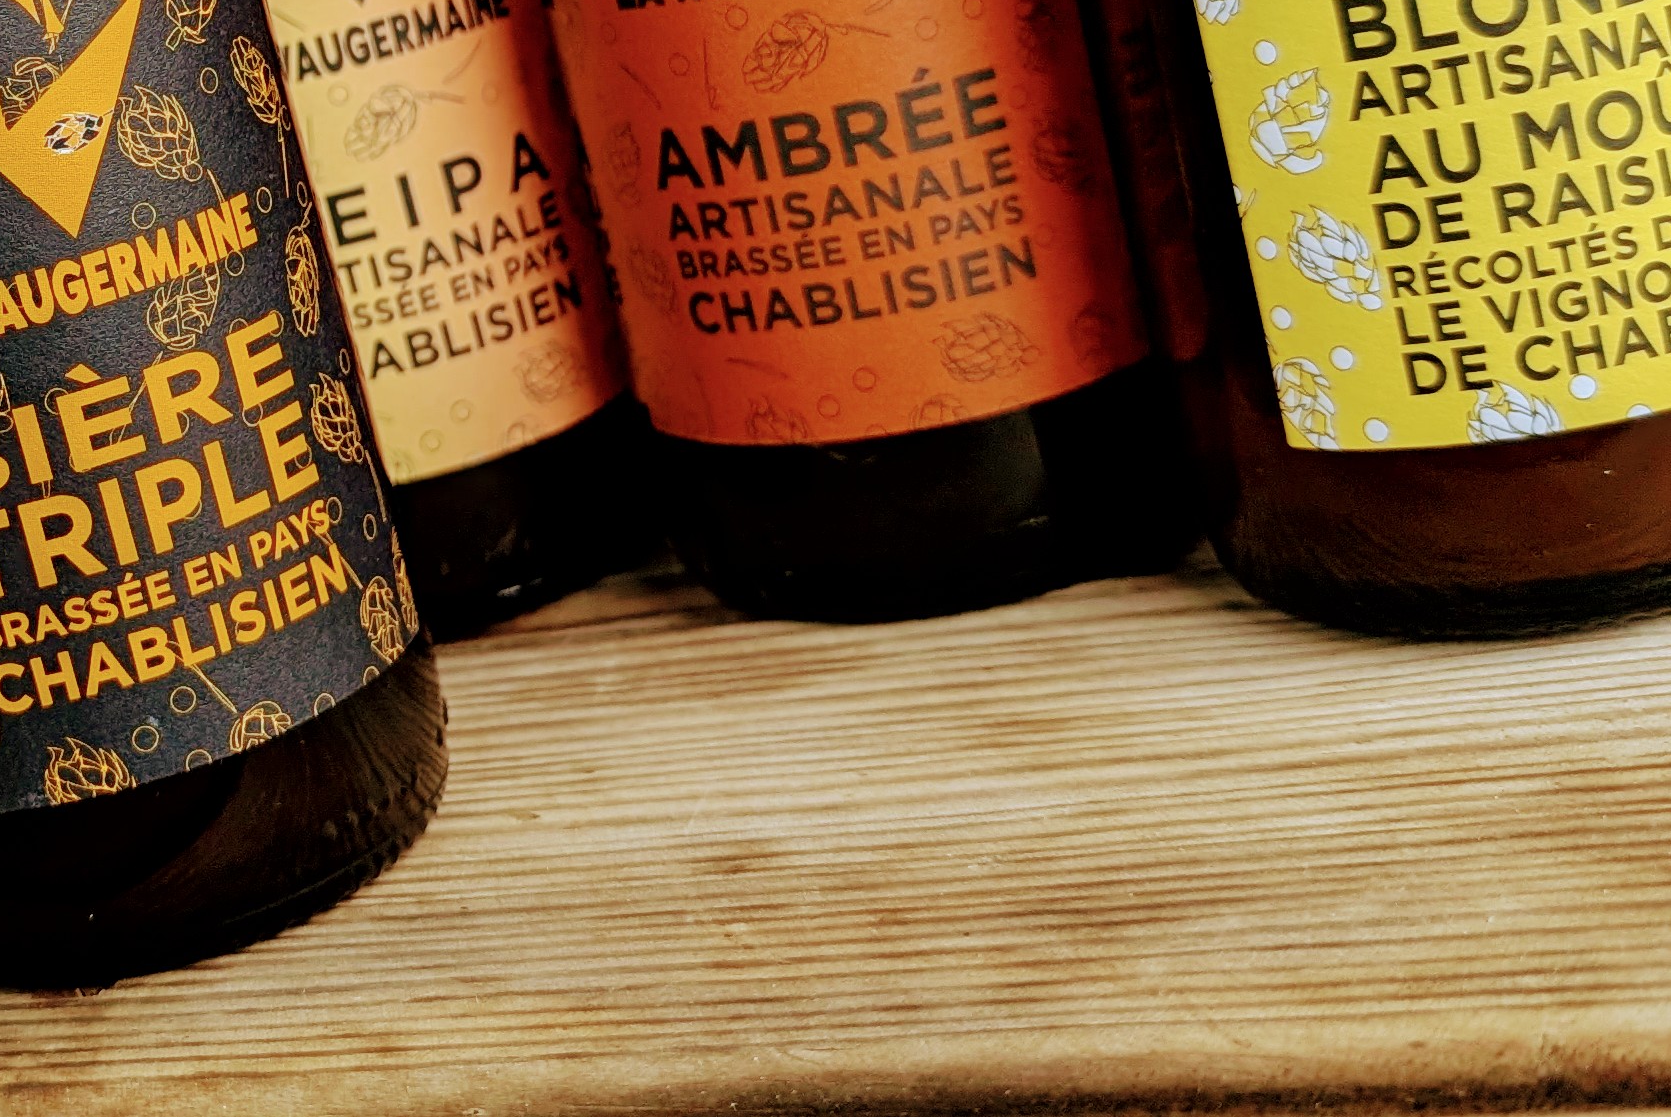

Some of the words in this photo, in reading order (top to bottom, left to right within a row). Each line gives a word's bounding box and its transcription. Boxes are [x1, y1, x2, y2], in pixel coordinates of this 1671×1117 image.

[1348, 5, 1671, 121] ARTISANA
[655, 67, 1008, 192] AMBRÉE
[1367, 120, 1482, 194] AU
[325, 132, 550, 247] EIPA
[668, 145, 1018, 243] ARTISANALE
[676, 232, 846, 281] BRASSÉE
[861, 222, 917, 261] EN
[930, 195, 1025, 243] PAYS
[1371, 191, 1470, 250] DE
[1490, 148, 1671, 233] RAISI
[338, 190, 562, 294] TISANALE
[352, 281, 440, 330] SSÉE
[448, 266, 494, 305] EN
[503, 234, 569, 280] PAYS
[687, 236, 1038, 336] CHABLISIEN
[1385, 221, 1638, 299] RÉCOLTÉS
[368, 268, 582, 380] ABLISIEN
[1394, 299, 1468, 346] LE
[1480, 260, 1671, 333] VIGNO
[1400, 344, 1494, 399] DE
[183, 545, 242, 595] EN
[251, 499, 331, 568] PAYS
